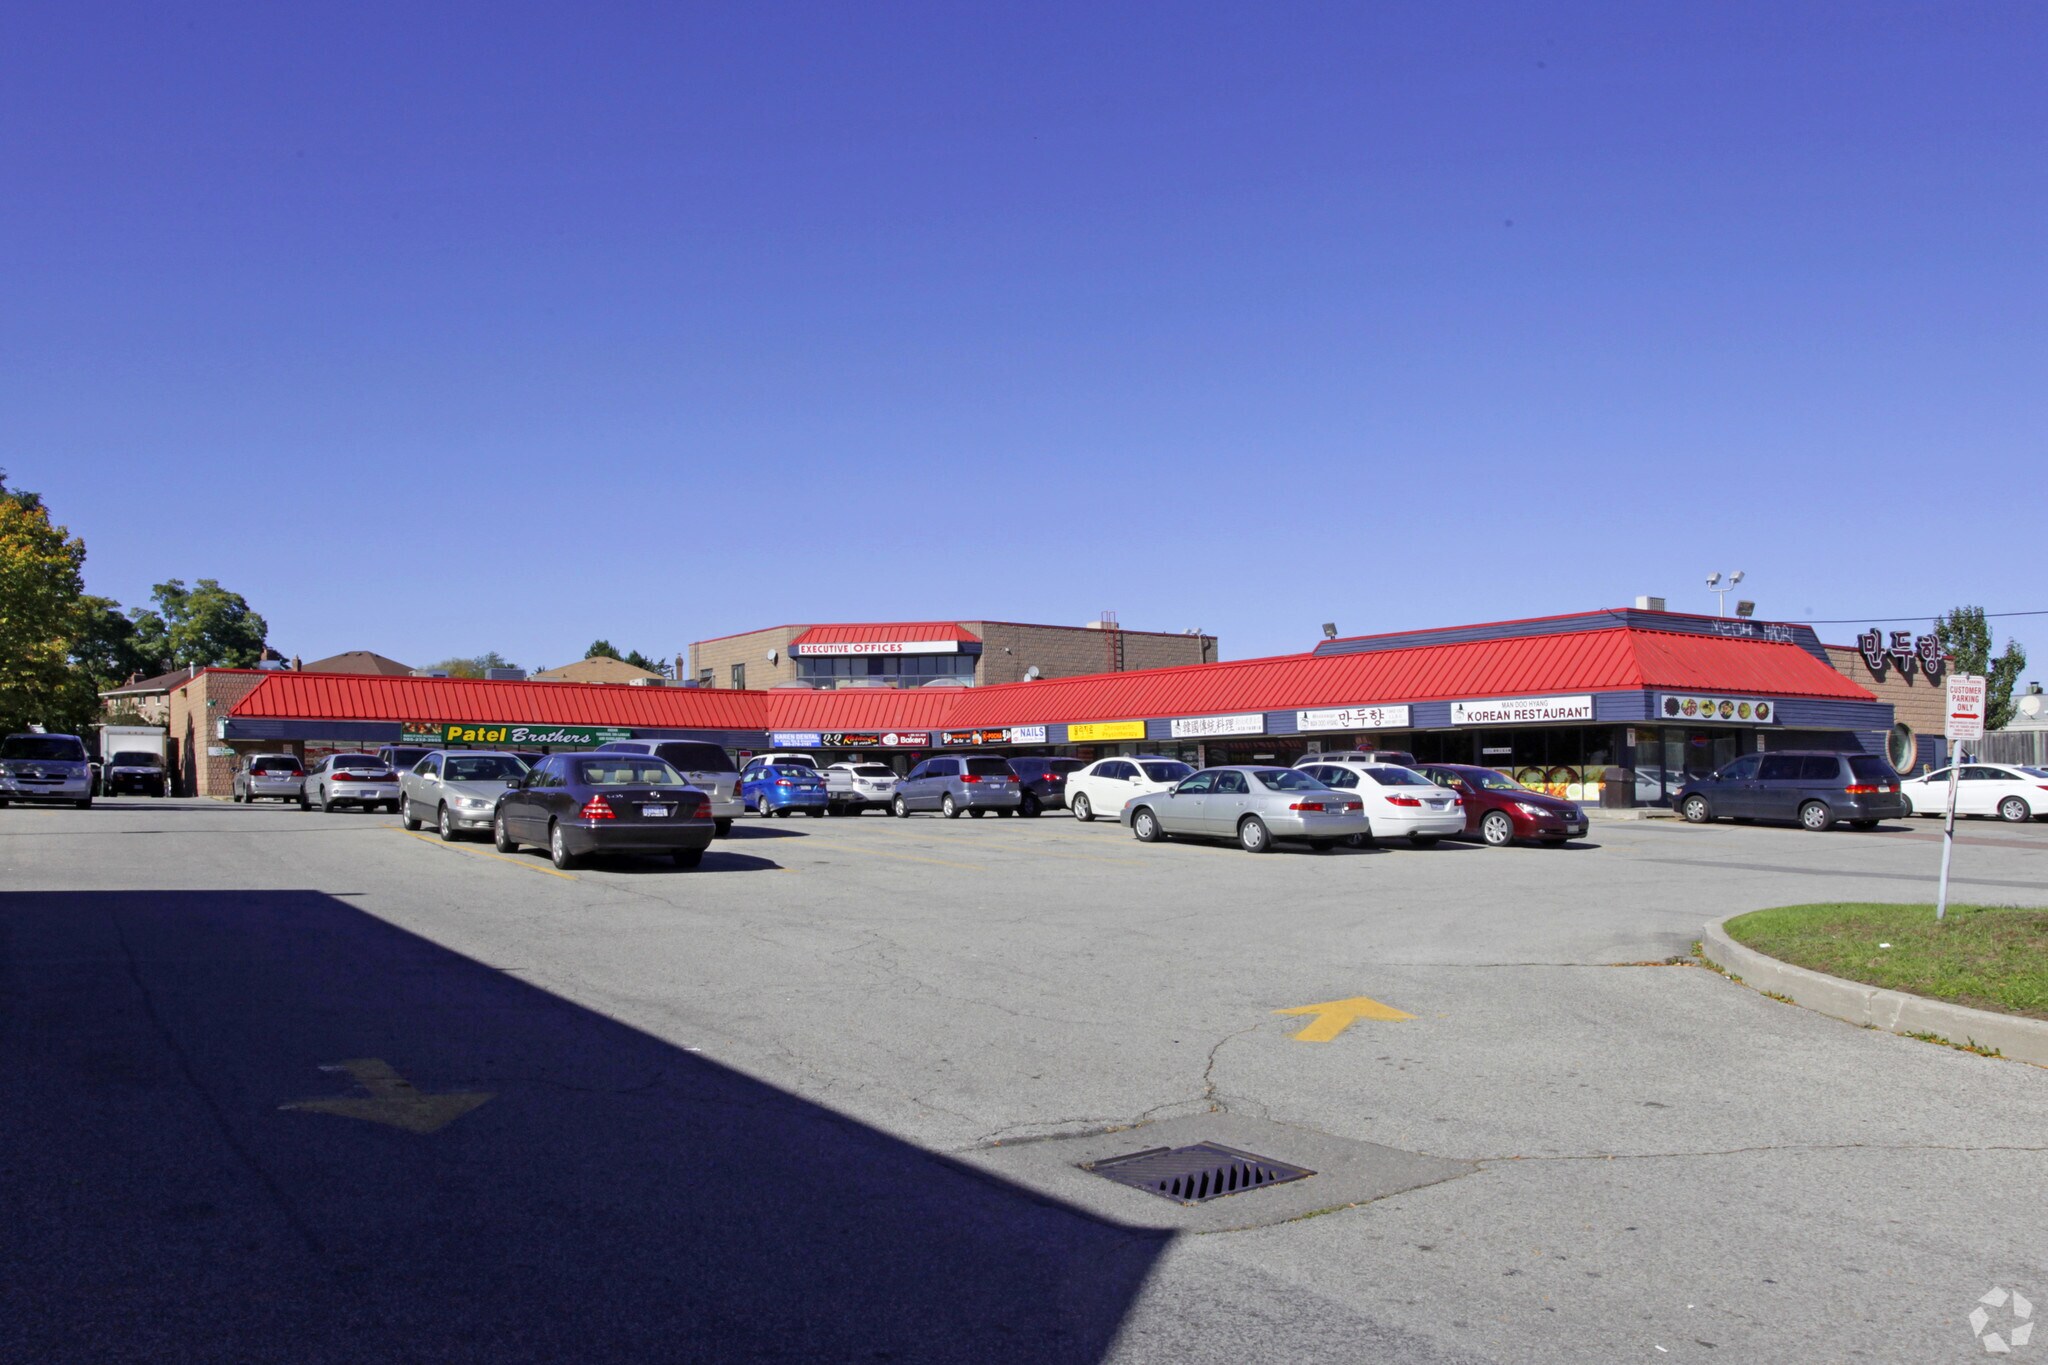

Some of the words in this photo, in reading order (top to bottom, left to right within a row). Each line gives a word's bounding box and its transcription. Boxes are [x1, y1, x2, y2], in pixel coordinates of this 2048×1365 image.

[801, 645, 849, 654] EXECUTIVE
[853, 643, 903, 653] OFFICES
[1858, 628, 1944, 674] 만두향
[1949, 686, 1982, 695] CUSTOMER
[1951, 694, 1980, 704] PARKING
[1957, 704, 1974, 712] ONLY
[1338, 708, 1384, 728] 만두향
[1467, 710, 1510, 722] KOREAN
[1514, 706, 1590, 720] RESTAURANT
[447, 726, 507, 742] Patel
[512, 728, 592, 743] Brothers
[1020, 726, 1044, 737] NAILS
[900, 736, 926, 744] Bakery
